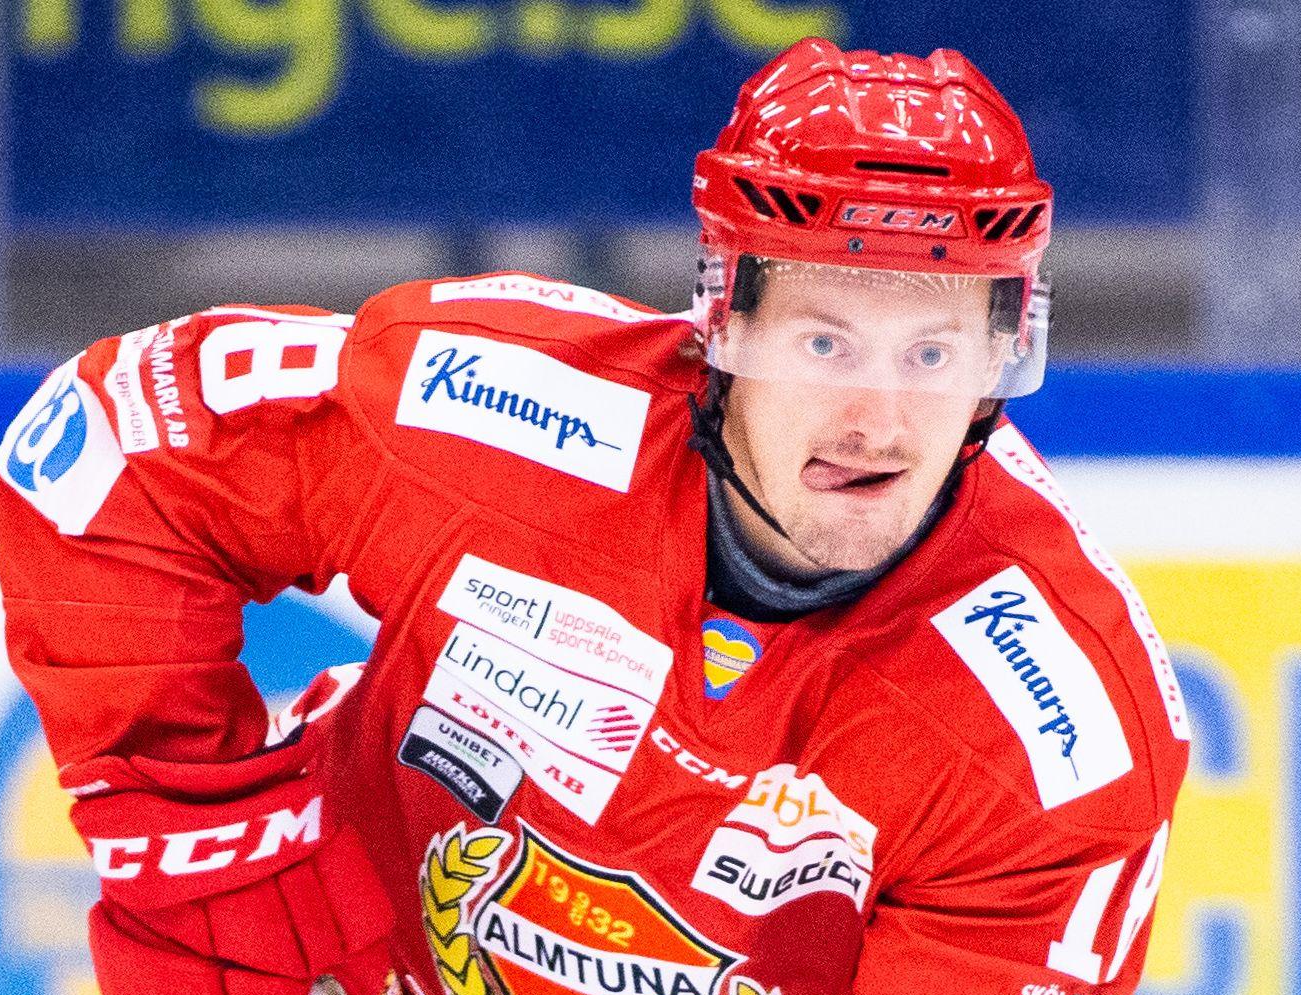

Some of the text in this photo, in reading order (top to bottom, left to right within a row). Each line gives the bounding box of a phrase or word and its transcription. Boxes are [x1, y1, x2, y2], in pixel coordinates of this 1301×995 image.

[841, 205, 957, 231] CCM
[421, 347, 623, 451] Kinnarps
[464, 576, 539, 620] sport
[479, 600, 531, 632] ringen
[444, 635, 585, 731] Lindahl
[964, 590, 1080, 782] Kinnarps
[438, 722, 503, 768] UNIBET
[651, 725, 748, 789] CCM
[544, 764, 586, 796] AB
[91, 795, 323, 880] CCM
